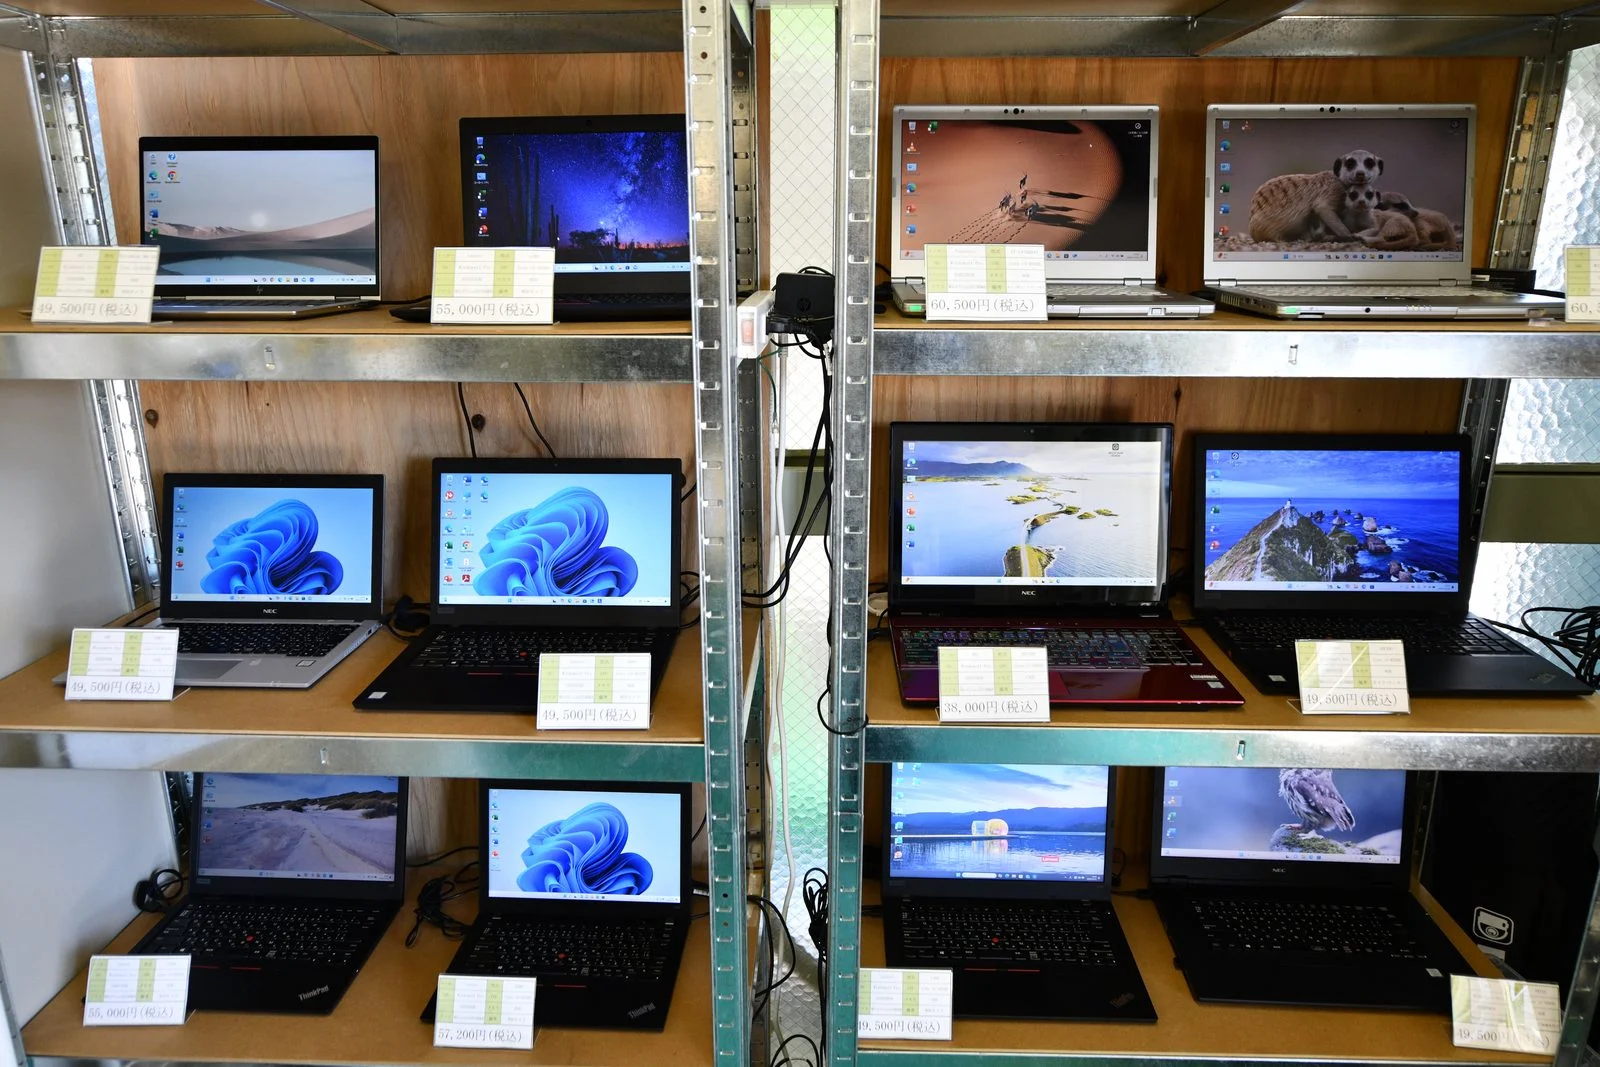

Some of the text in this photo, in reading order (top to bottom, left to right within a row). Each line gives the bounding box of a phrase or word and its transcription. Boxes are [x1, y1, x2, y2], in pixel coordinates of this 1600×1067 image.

[39, 303, 138, 316] 49,500円(税込)
[436, 303, 540, 316] 55,000円(税込)
[931, 298, 1034, 312] 60,500円(税込)
[71, 681, 161, 694] 49,500円(税込)
[944, 700, 1038, 713] 38,000円(税込)
[543, 708, 637, 721] 49,500円(税込)
[298, 984, 329, 1001] ThinkPad
[88, 1006, 174, 1018] 55,000円(税込)
[438, 1028, 522, 1042] 57,200円(税込)
